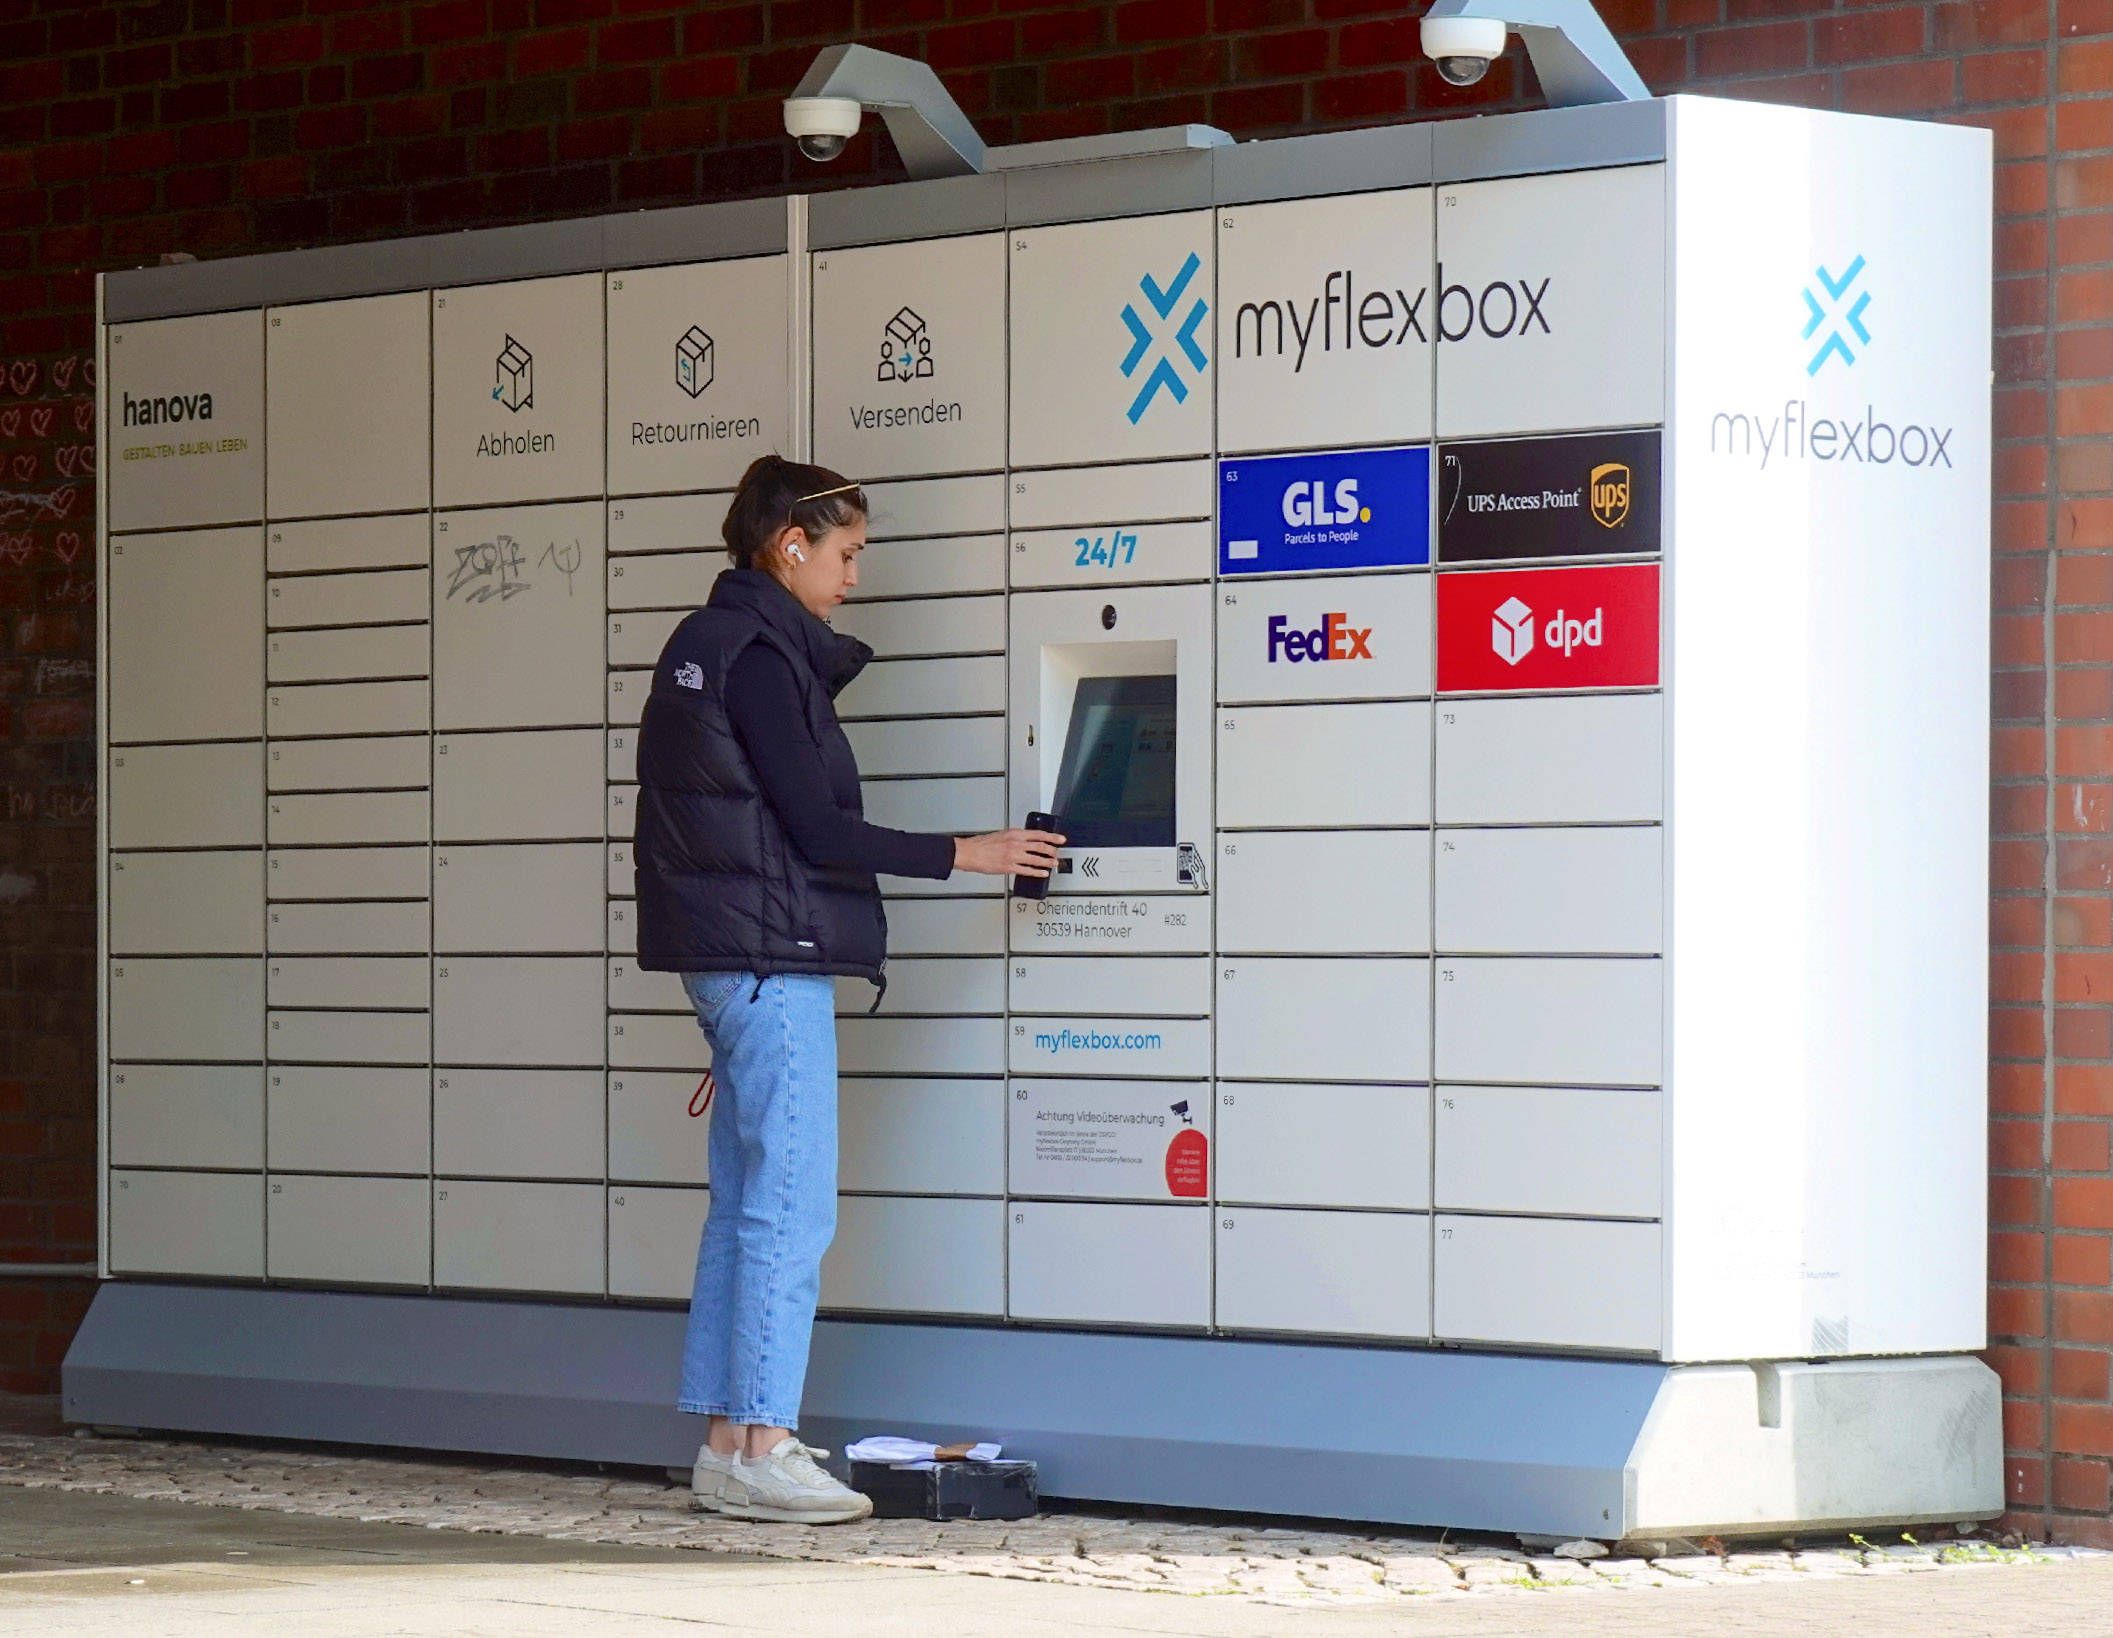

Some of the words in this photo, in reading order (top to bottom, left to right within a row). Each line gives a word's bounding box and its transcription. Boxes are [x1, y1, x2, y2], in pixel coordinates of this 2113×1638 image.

[1445, 197, 1457, 206] 70
[1223, 219, 1234, 228] 62
[1017, 241, 1028, 251] 54
[819, 261, 828, 270] 41
[613, 281, 624, 290] 28
[1235, 262, 1551, 373] myflexbox
[123, 391, 212, 427] hanova
[849, 398, 962, 430] Versenden
[631, 415, 760, 446] Retournieren
[1711, 400, 1953, 470] myflexbox
[476, 430, 555, 457] Abholen
[122, 445, 175, 461] GESTALTEN
[179, 441, 212, 457] BAUEN
[216, 437, 247, 453] LEBEN
[1445, 456, 1457, 467] 71
[1227, 471, 1239, 481] 63
[1016, 484, 1026, 493] 55
[1467, 494, 1496, 513] UPS
[1497, 493, 1541, 511] Access
[1593, 482, 1628, 518] ups
[615, 511, 625, 520] 29
[440, 522, 449, 531] 22
[1284, 531, 1316, 544] Parcels
[1317, 532, 1328, 543] to
[1328, 529, 1360, 544] People
[1016, 543, 1026, 552] 56
[1074, 530, 1137, 569] 24/7
[614, 567, 624, 577] 30
[1225, 596, 1237, 605] 64
[614, 624, 622, 633] 31
[1544, 607, 1603, 658] dpd
[1268, 612, 1373, 664] FedEx
[614, 682, 624, 692] 32
[1444, 714, 1456, 724] 73
[1224, 720, 1236, 729] 65
[615, 739, 623, 748] 33
[614, 796, 624, 806] 34
[1225, 845, 1237, 855] 66
[1443, 842, 1456, 851] 74
[439, 856, 449, 866] 24
[614, 853, 624, 862] 35
[1017, 903, 1028, 912] 57
[1131, 902, 1148, 917] 40
[614, 911, 624, 920] 36
[1164, 914, 1188, 927] #282
[1036, 922, 1072, 938] 30539
[1074, 923, 1133, 938] Hannover
[440, 968, 449, 977] 25
[615, 968, 624, 977] 37
[1016, 968, 1026, 977] 58
[1224, 970, 1236, 980] 67
[1443, 971, 1454, 981] 75
[614, 1026, 625, 1035] 38
[1015, 1026, 1025, 1036] 59
[1035, 1029, 1162, 1054] myflexbox.com
[440, 1079, 449, 1088] 26
[614, 1082, 624, 1090] 39
[1017, 1090, 1028, 1100] 60
[1224, 1096, 1235, 1105] 68
[1443, 1099, 1455, 1109] 76
[1036, 1110, 1075, 1125] Achtung
[1076, 1110, 1166, 1128] Videoüberwachung
[439, 1191, 448, 1200] 27
[615, 1197, 625, 1206] 40
[1016, 1214, 1024, 1223] 61
[1223, 1220, 1235, 1229] 69
[1442, 1229, 1453, 1239] 77
